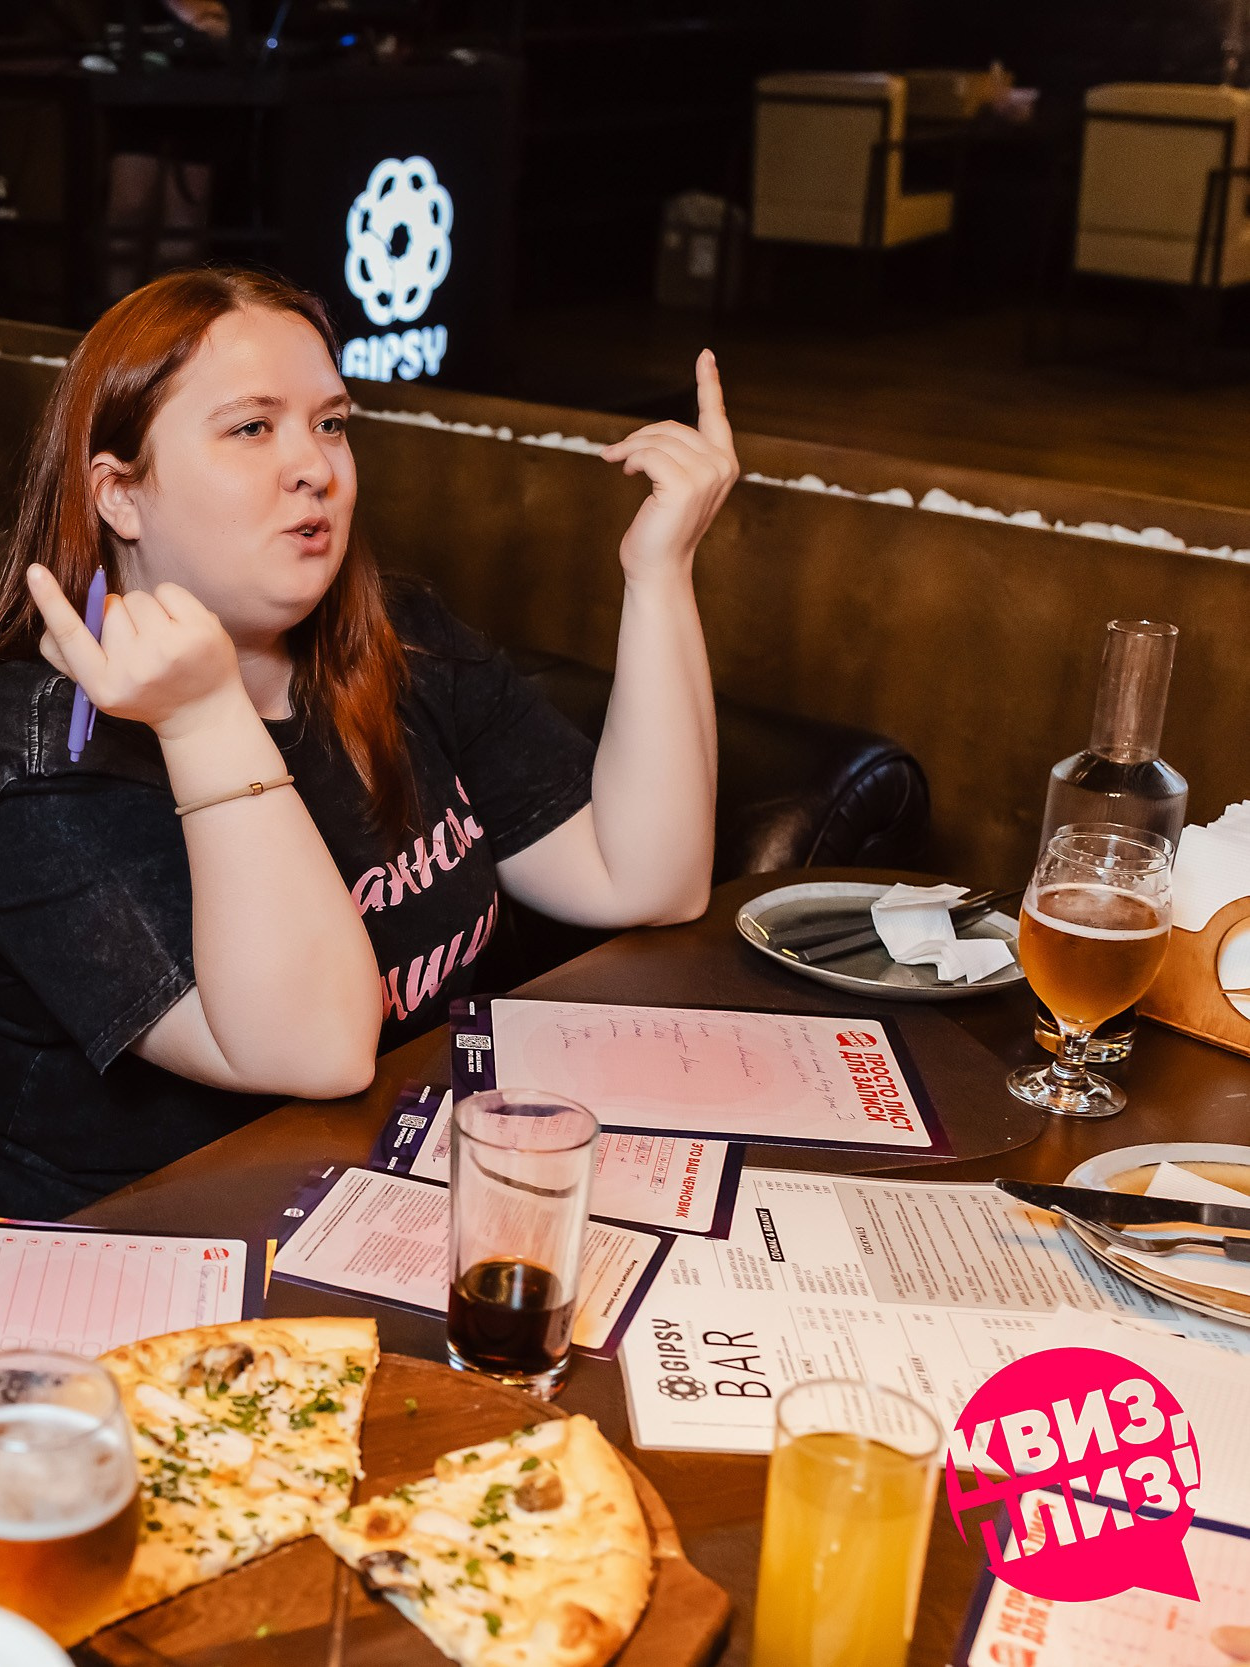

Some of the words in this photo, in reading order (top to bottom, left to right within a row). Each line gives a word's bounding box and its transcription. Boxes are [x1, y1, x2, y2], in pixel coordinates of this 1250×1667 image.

[342, 324, 448, 382] GIPSY
[838, 1050, 869, 1074] ДЛЯ
[851, 1075, 889, 1122] ЗАПИСИ
[863, 1052, 900, 1098] ПРОСТО
[882, 1099, 915, 1132] ЛИСТ
[689, 1142, 704, 1157] ЭТО
[685, 1157, 700, 1174] ВАШ
[675, 1176, 696, 1219] ЧЕРНОВИК
[757, 1209, 774, 1231] BRANDY
[766, 1237, 782, 1259] COGNAC
[855, 1226, 874, 1254] COCKTAILS
[652, 1319, 690, 1371] GIPSY
[702, 1331, 772, 1398] BAR
[801, 1359, 814, 1374] WINE
[910, 1356, 925, 1372] BEER
[916, 1373, 934, 1394] DRAFT
